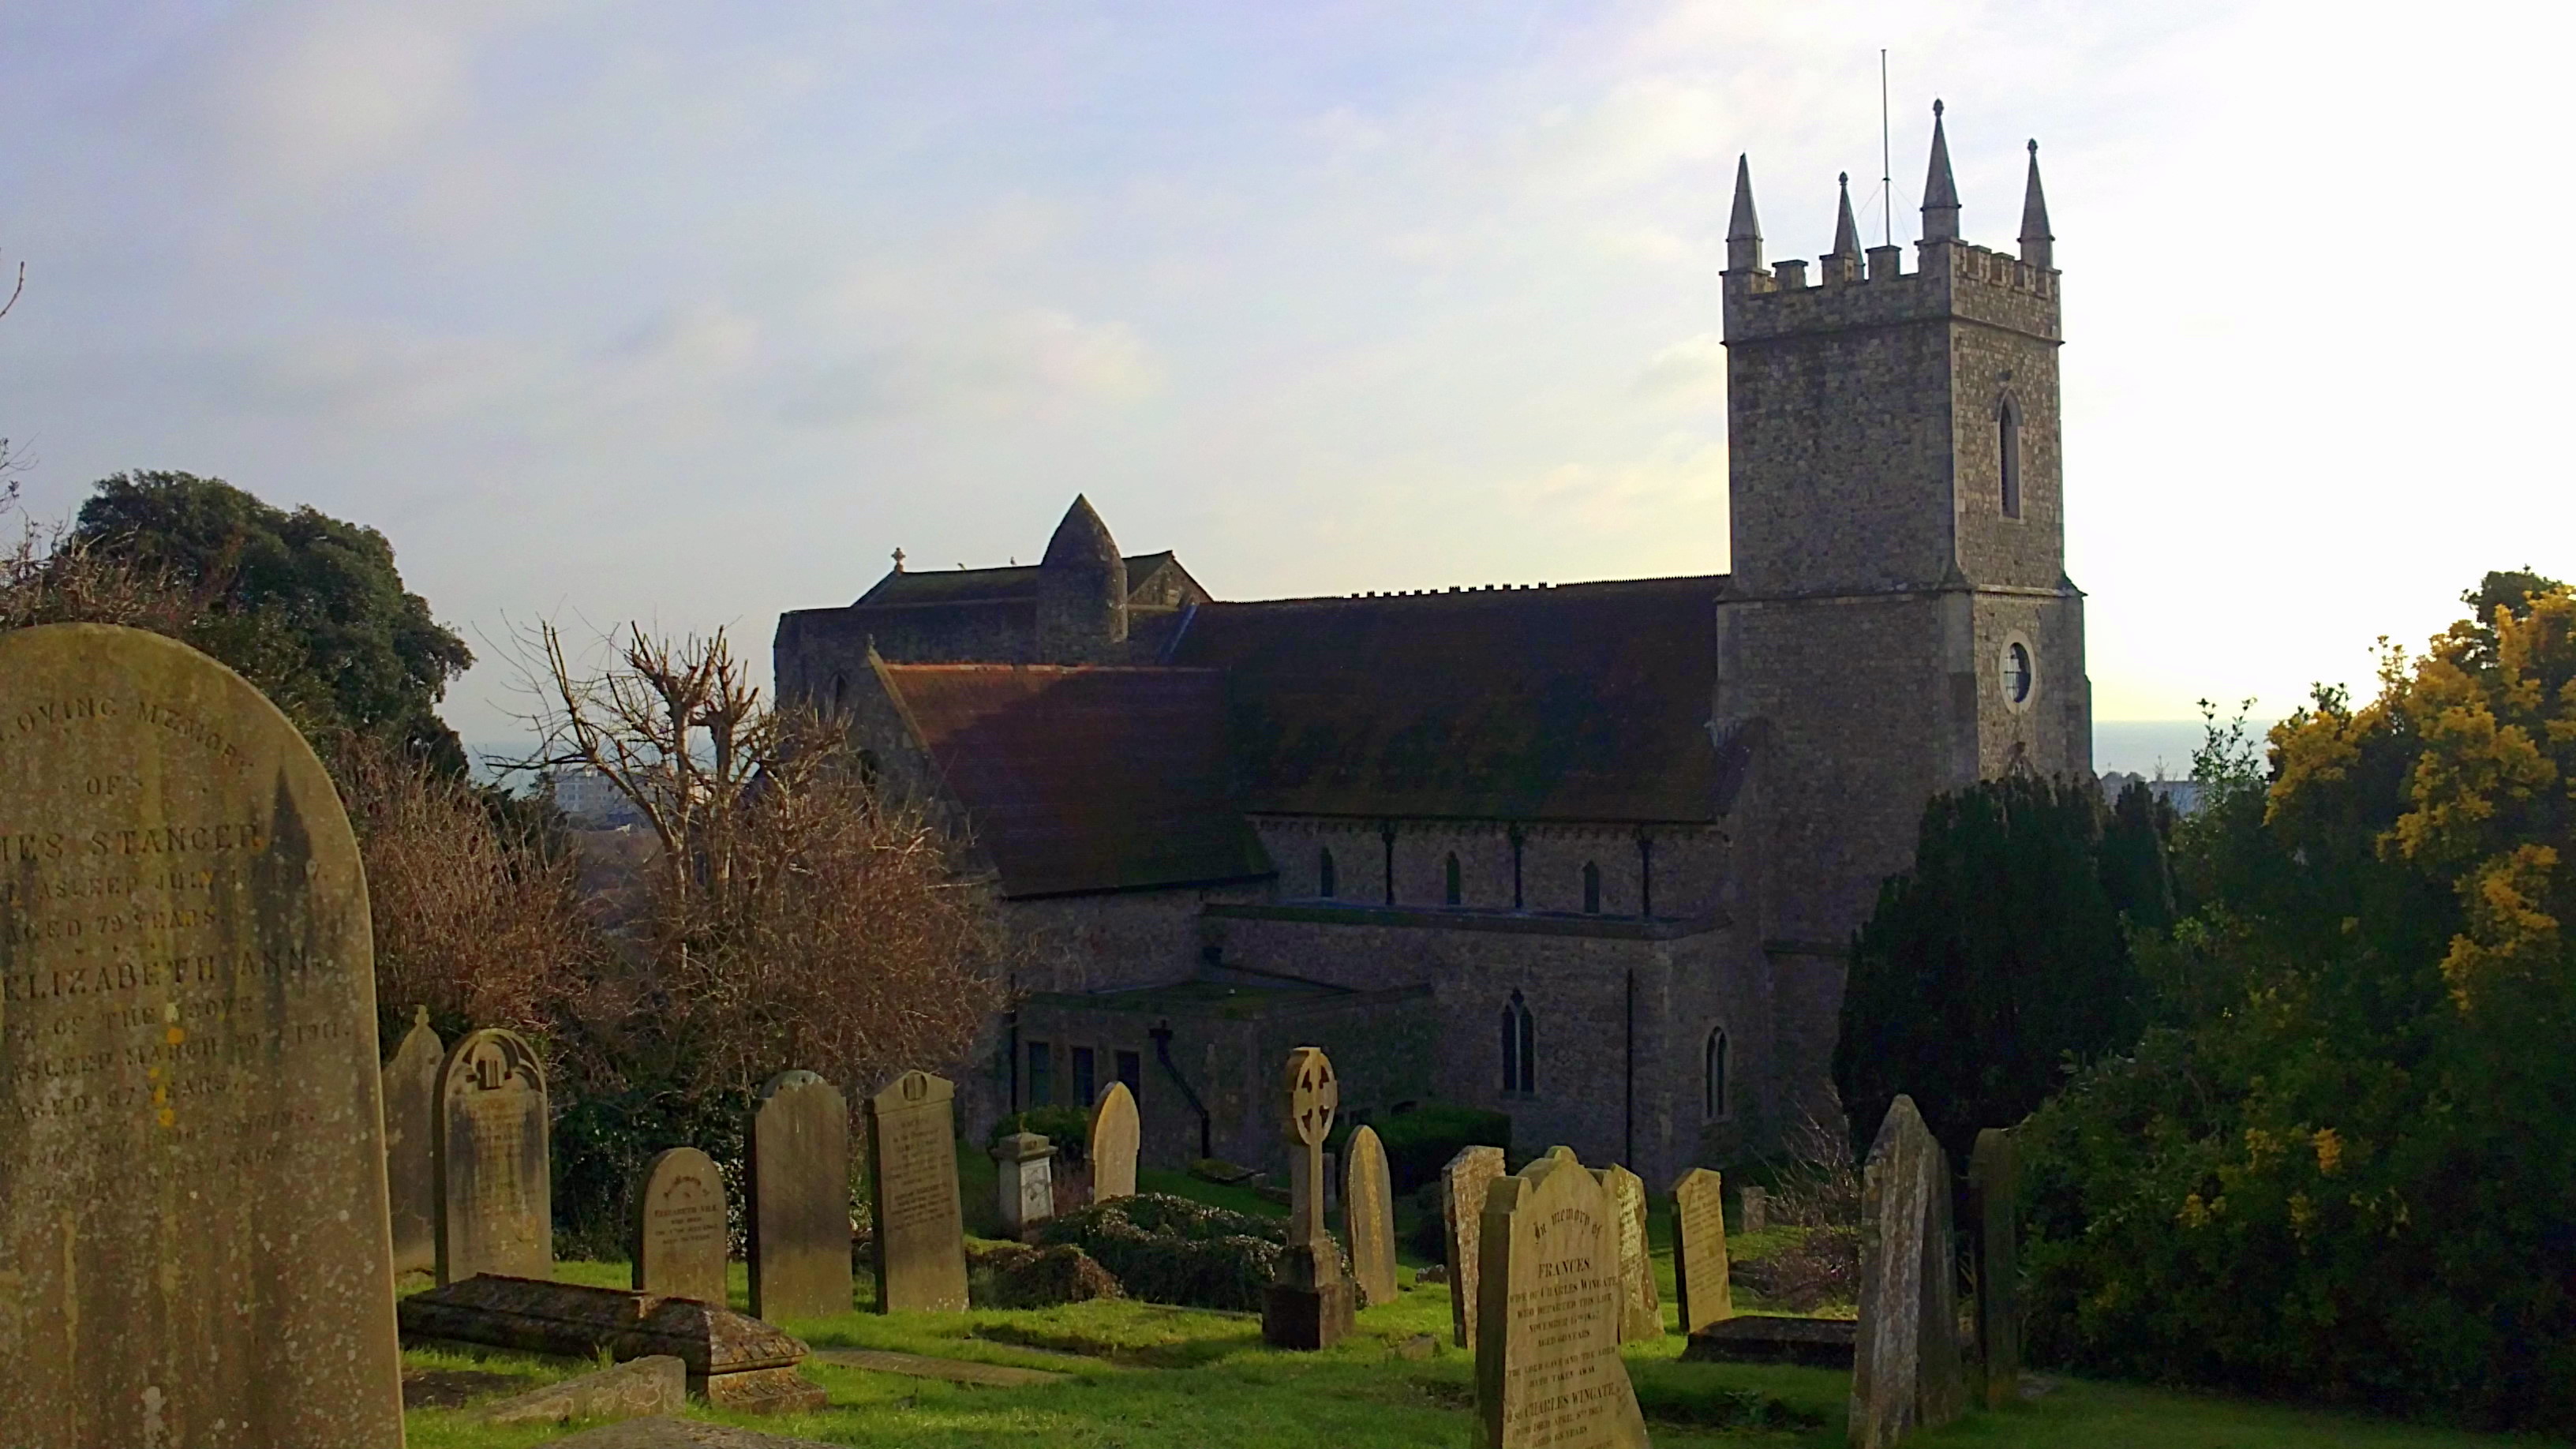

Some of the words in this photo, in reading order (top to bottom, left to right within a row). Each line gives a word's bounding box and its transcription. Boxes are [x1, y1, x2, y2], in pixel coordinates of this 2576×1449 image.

[0, 697, 118, 743] OVING
[85, 774, 122, 796] OF
[39, 875, 137, 900] ASLEEP
[96, 915, 123, 934] 79
[3, 955, 215, 1001] ELIZABETH
[101, 1007, 155, 1029] THE
[1552, 1208, 1589, 1226] memory
[1592, 1222, 1602, 1239] of
[1541, 1283, 1578, 1298] CHARLES
[1537, 1301, 1576, 1315] DEPARTED
[1580, 1297, 1594, 1308] THIS
[1529, 1317, 1568, 1333] NOVEMBER
[1525, 1395, 1569, 1418] CHARLES
